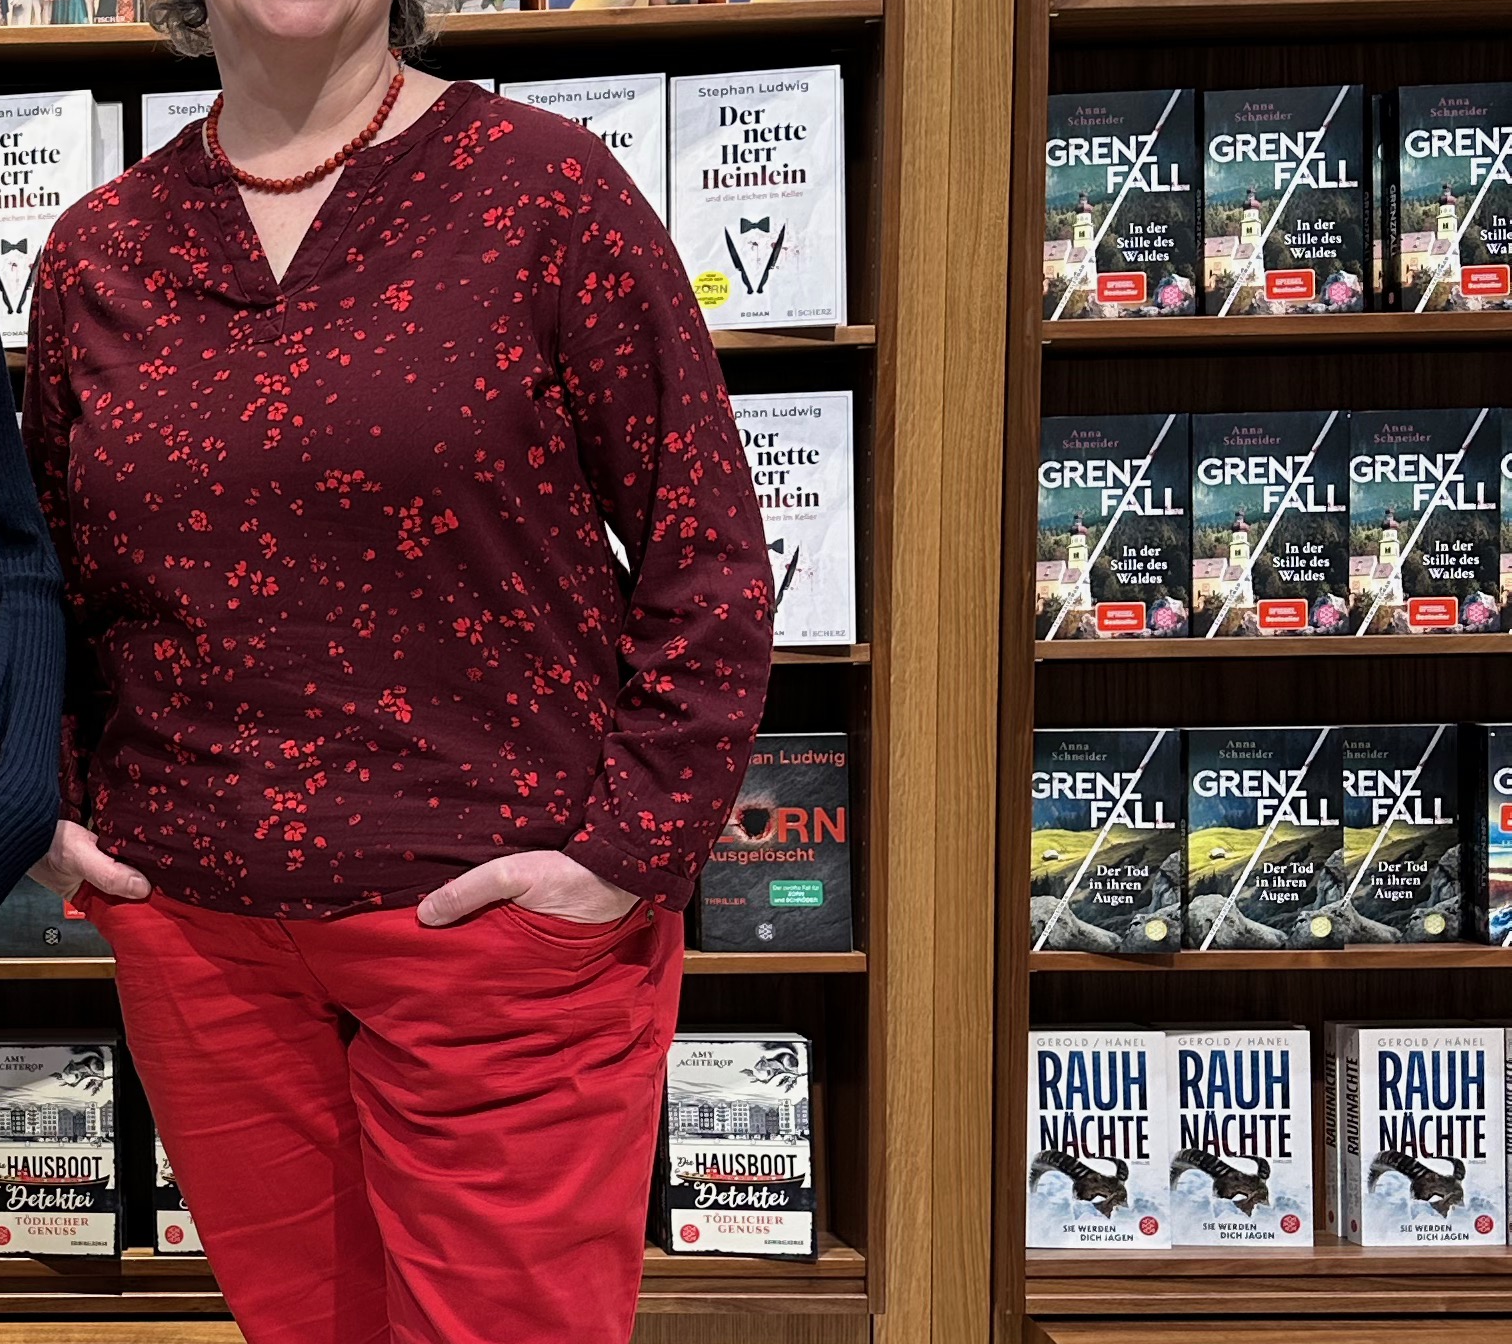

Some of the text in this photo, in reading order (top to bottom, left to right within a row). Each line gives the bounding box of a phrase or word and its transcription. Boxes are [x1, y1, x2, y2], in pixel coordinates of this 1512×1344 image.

[698, 80, 809, 98] Stephan Ludwig
[719, 105, 766, 128] Der
[743, 122, 807, 144] nette
[720, 144, 777, 165] Herr
[1208, 130, 1324, 164] GRENZ
[702, 163, 807, 191] Heinlein
[1274, 160, 1358, 190] FALL
[1296, 219, 1335, 230] In der
[1284, 232, 1343, 245] Stille des
[1290, 247, 1337, 259] Waldes
[780, 750, 845, 767] Ludwig
[1192, 769, 1307, 799] GRENZ
[1257, 798, 1340, 826] FALL
[1263, 862, 1314, 874] Der Tod
[1255, 876, 1307, 888] in ihren
[1259, 889, 1300, 903] Augen
[1037, 1035, 1146, 1047] GEROLD HÄNEL
[1037, 1049, 1148, 1112] RAUH
[1040, 1111, 1150, 1160] NÄCHTE
[8, 1156, 102, 1180] HAUSBOOT
[5, 1185, 95, 1212] Detektei
[15, 1215, 89, 1227] TÖDLICHER
[1063, 1224, 1117, 1234] SIE WERDEN
[28, 1226, 77, 1236] GENUSS
[1080, 1232, 1134, 1242] DICH JAGEN
